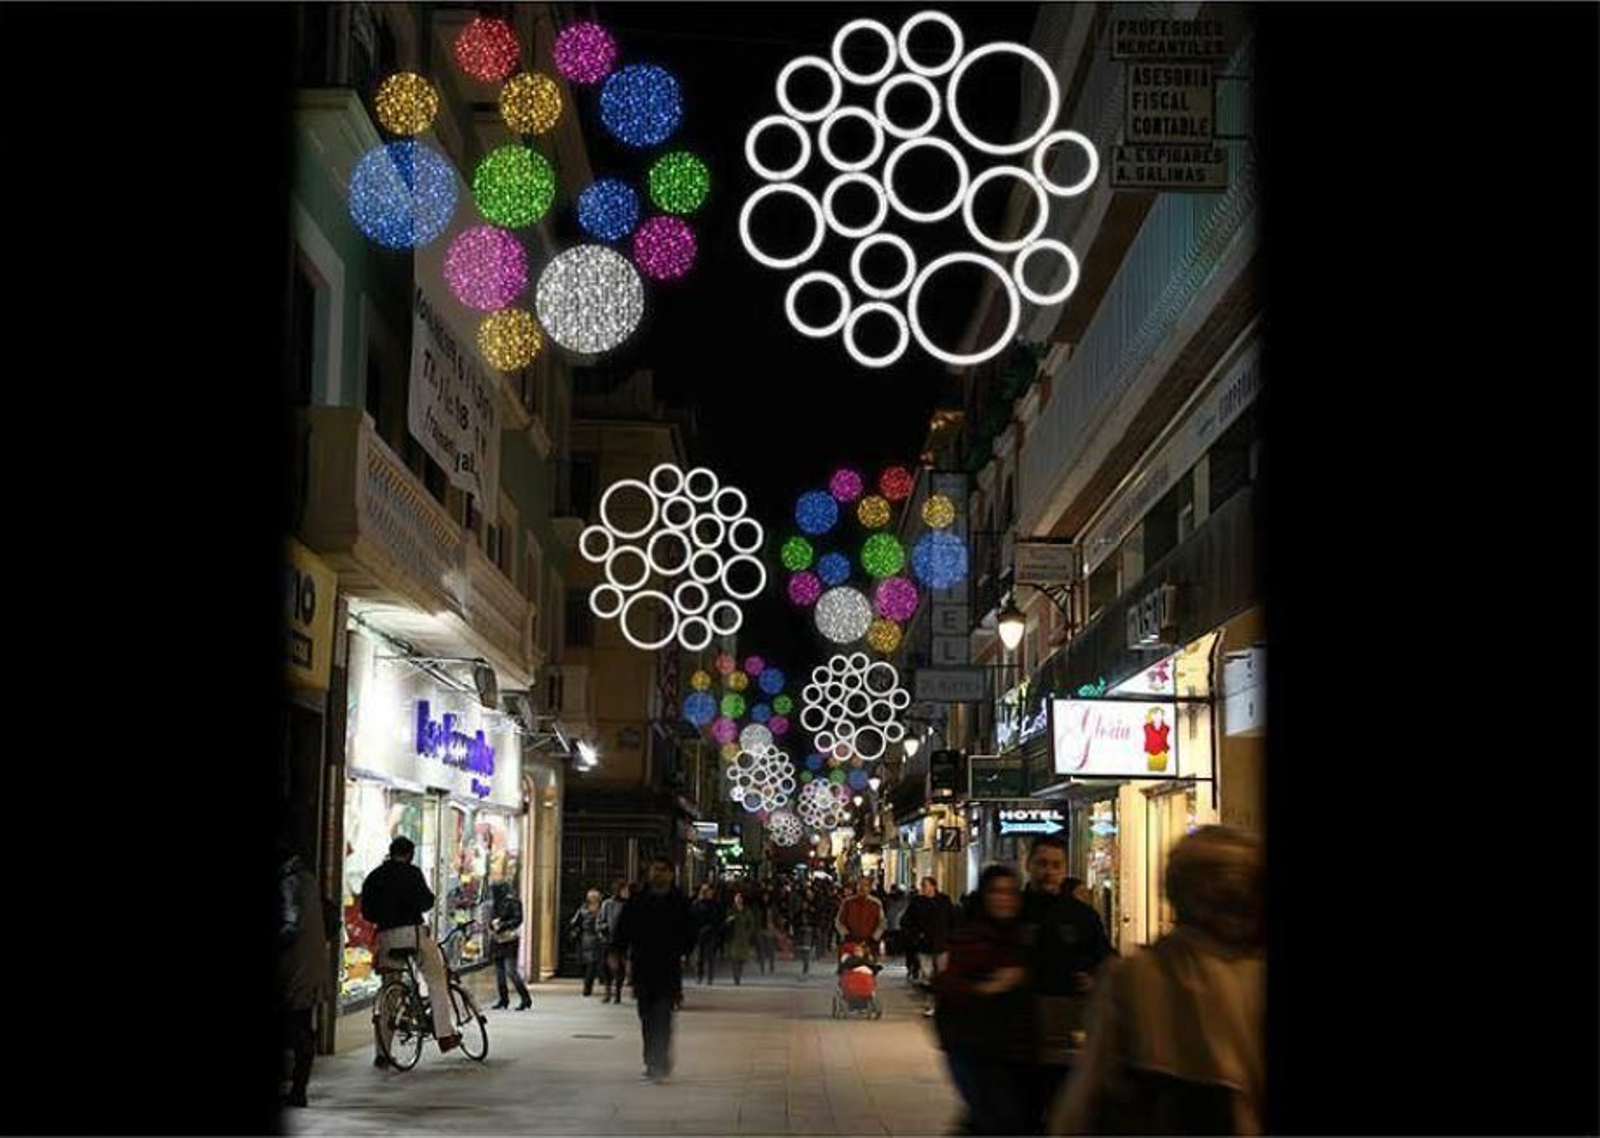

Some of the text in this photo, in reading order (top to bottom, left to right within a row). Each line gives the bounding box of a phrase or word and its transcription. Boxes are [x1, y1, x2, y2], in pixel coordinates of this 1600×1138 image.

[1133, 91, 1189, 111] FISCAL
[1132, 116, 1208, 136] CONTABLE
[999, 809, 1065, 821] HOTEL
[943, 828, 958, 849] 7
